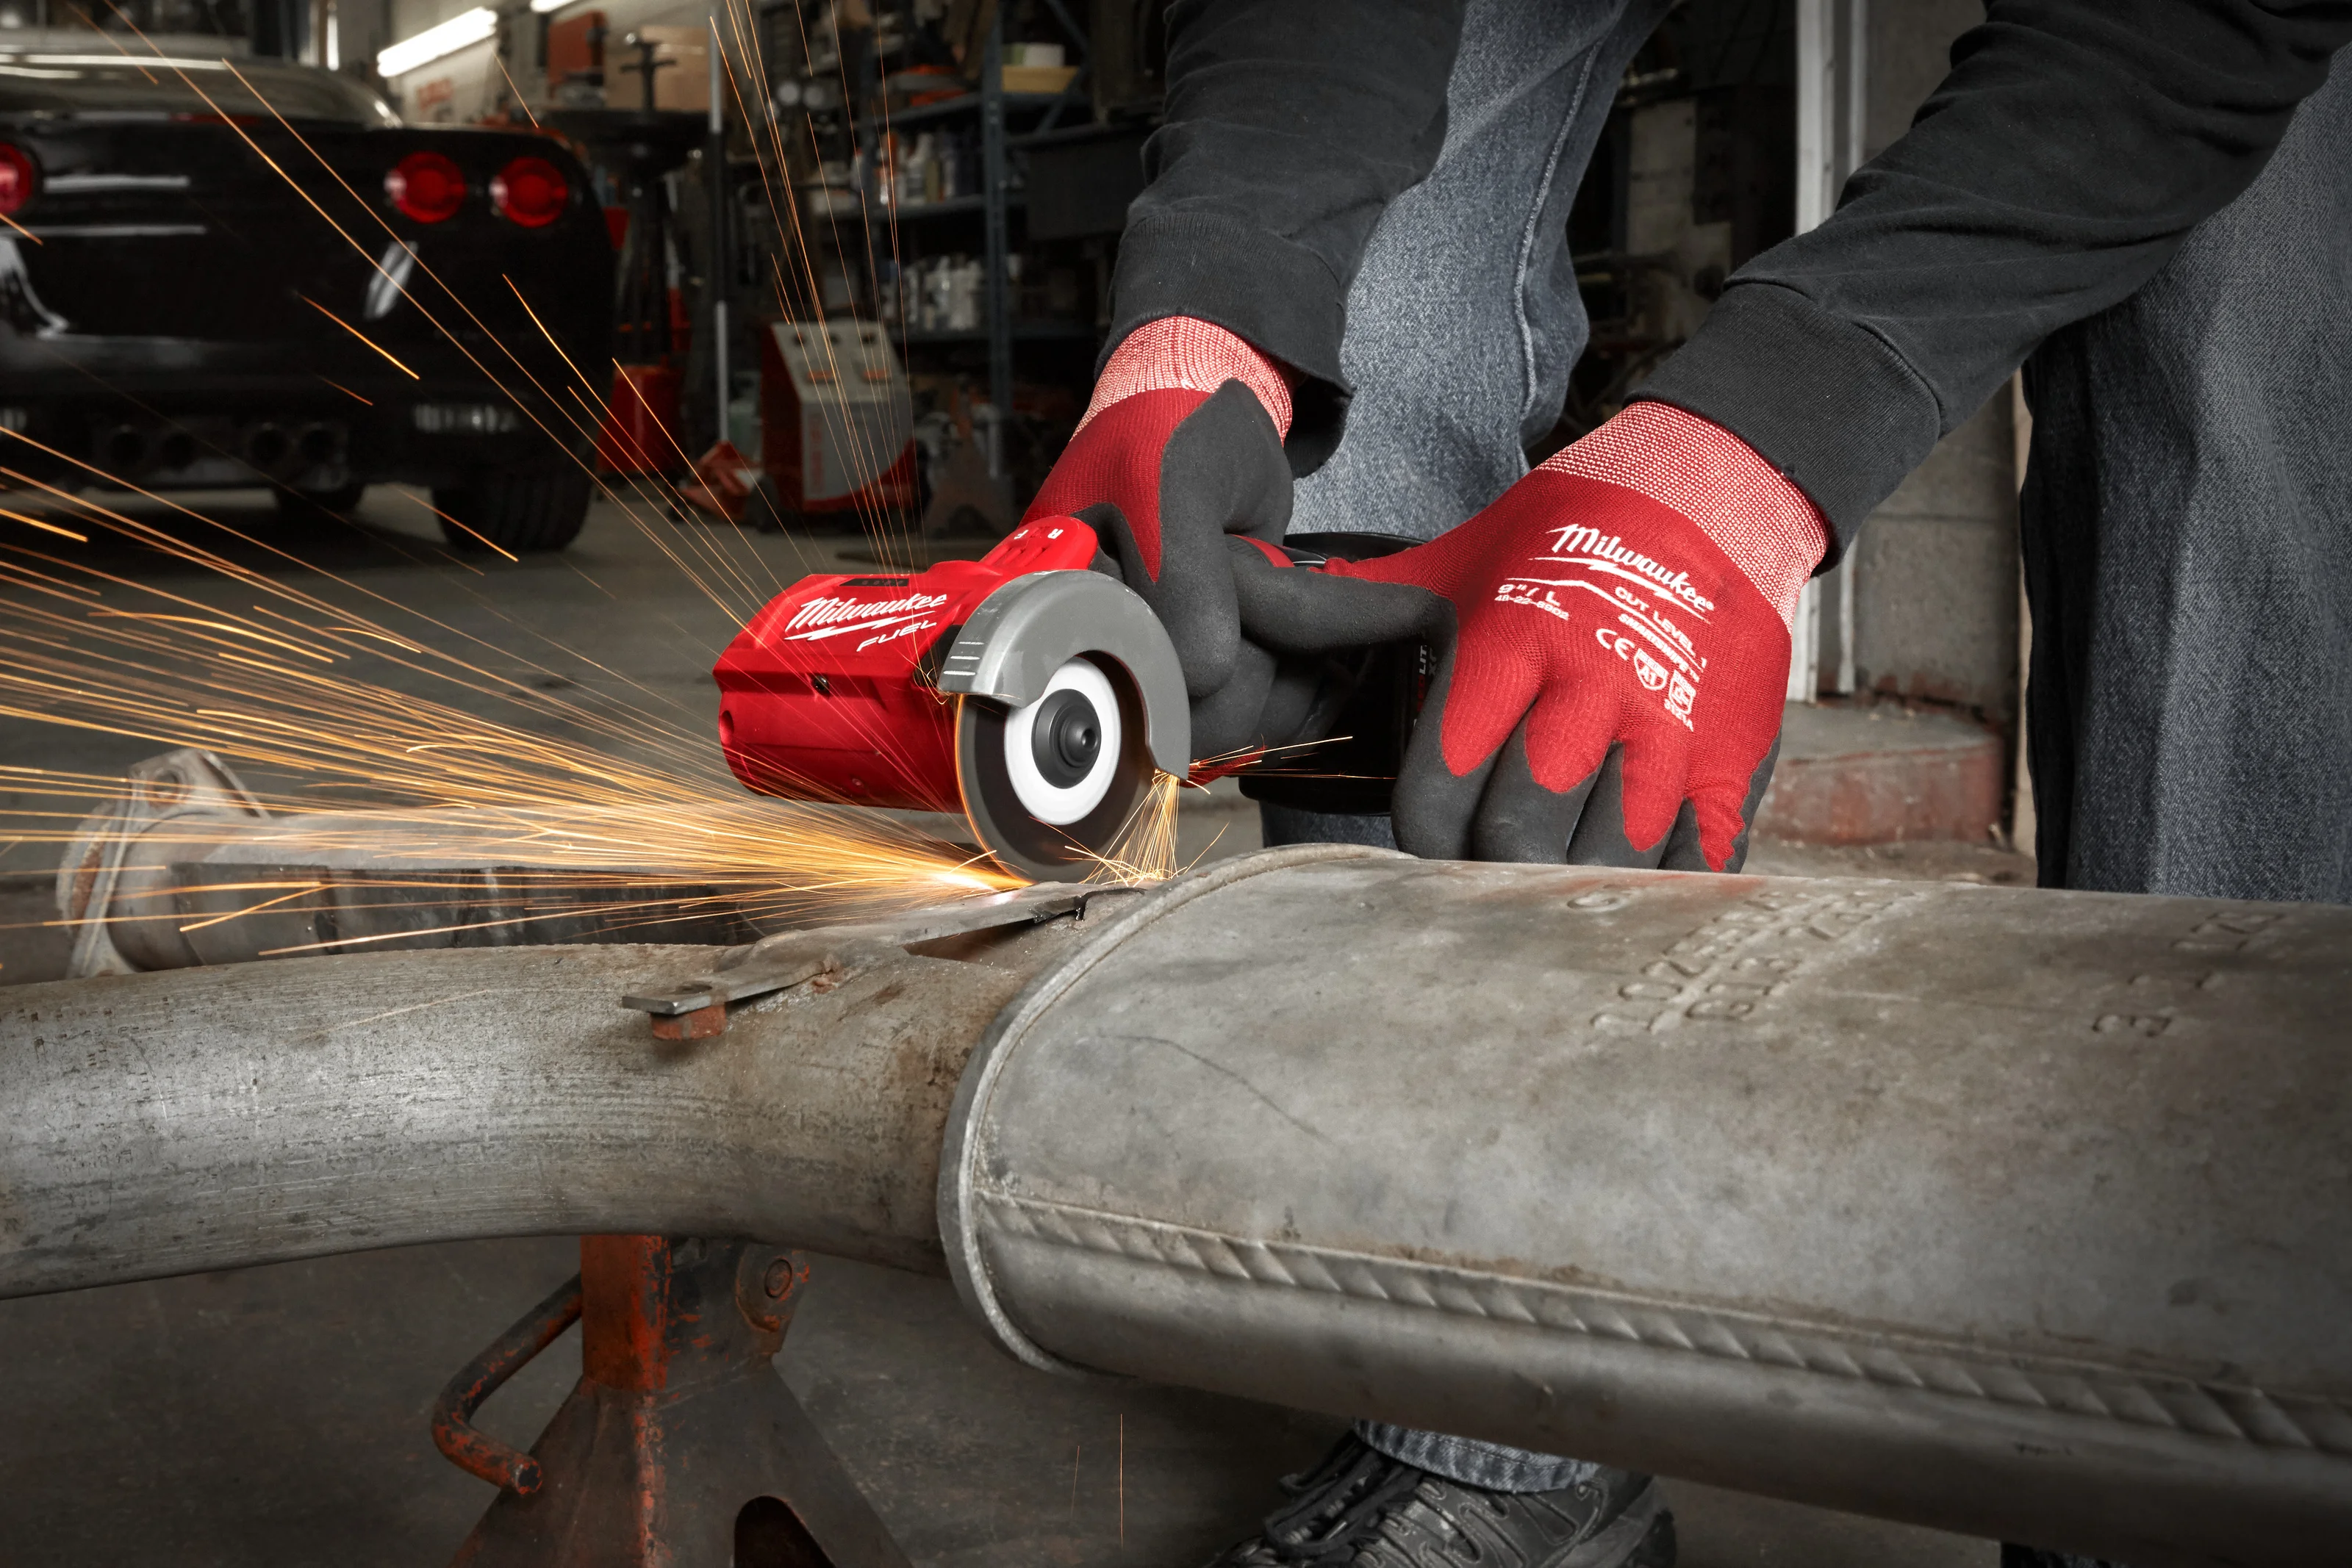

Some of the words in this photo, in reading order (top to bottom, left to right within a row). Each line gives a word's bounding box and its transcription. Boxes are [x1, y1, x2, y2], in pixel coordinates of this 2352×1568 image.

[1014, 529, 1029, 540] F
[1047, 528, 1064, 539] R
[784, 593, 947, 633] Milwaukee
[1615, 586, 1650, 611] CUT
[1653, 611, 1696, 658] LEVEL
[856, 619, 937, 652] FUEL
